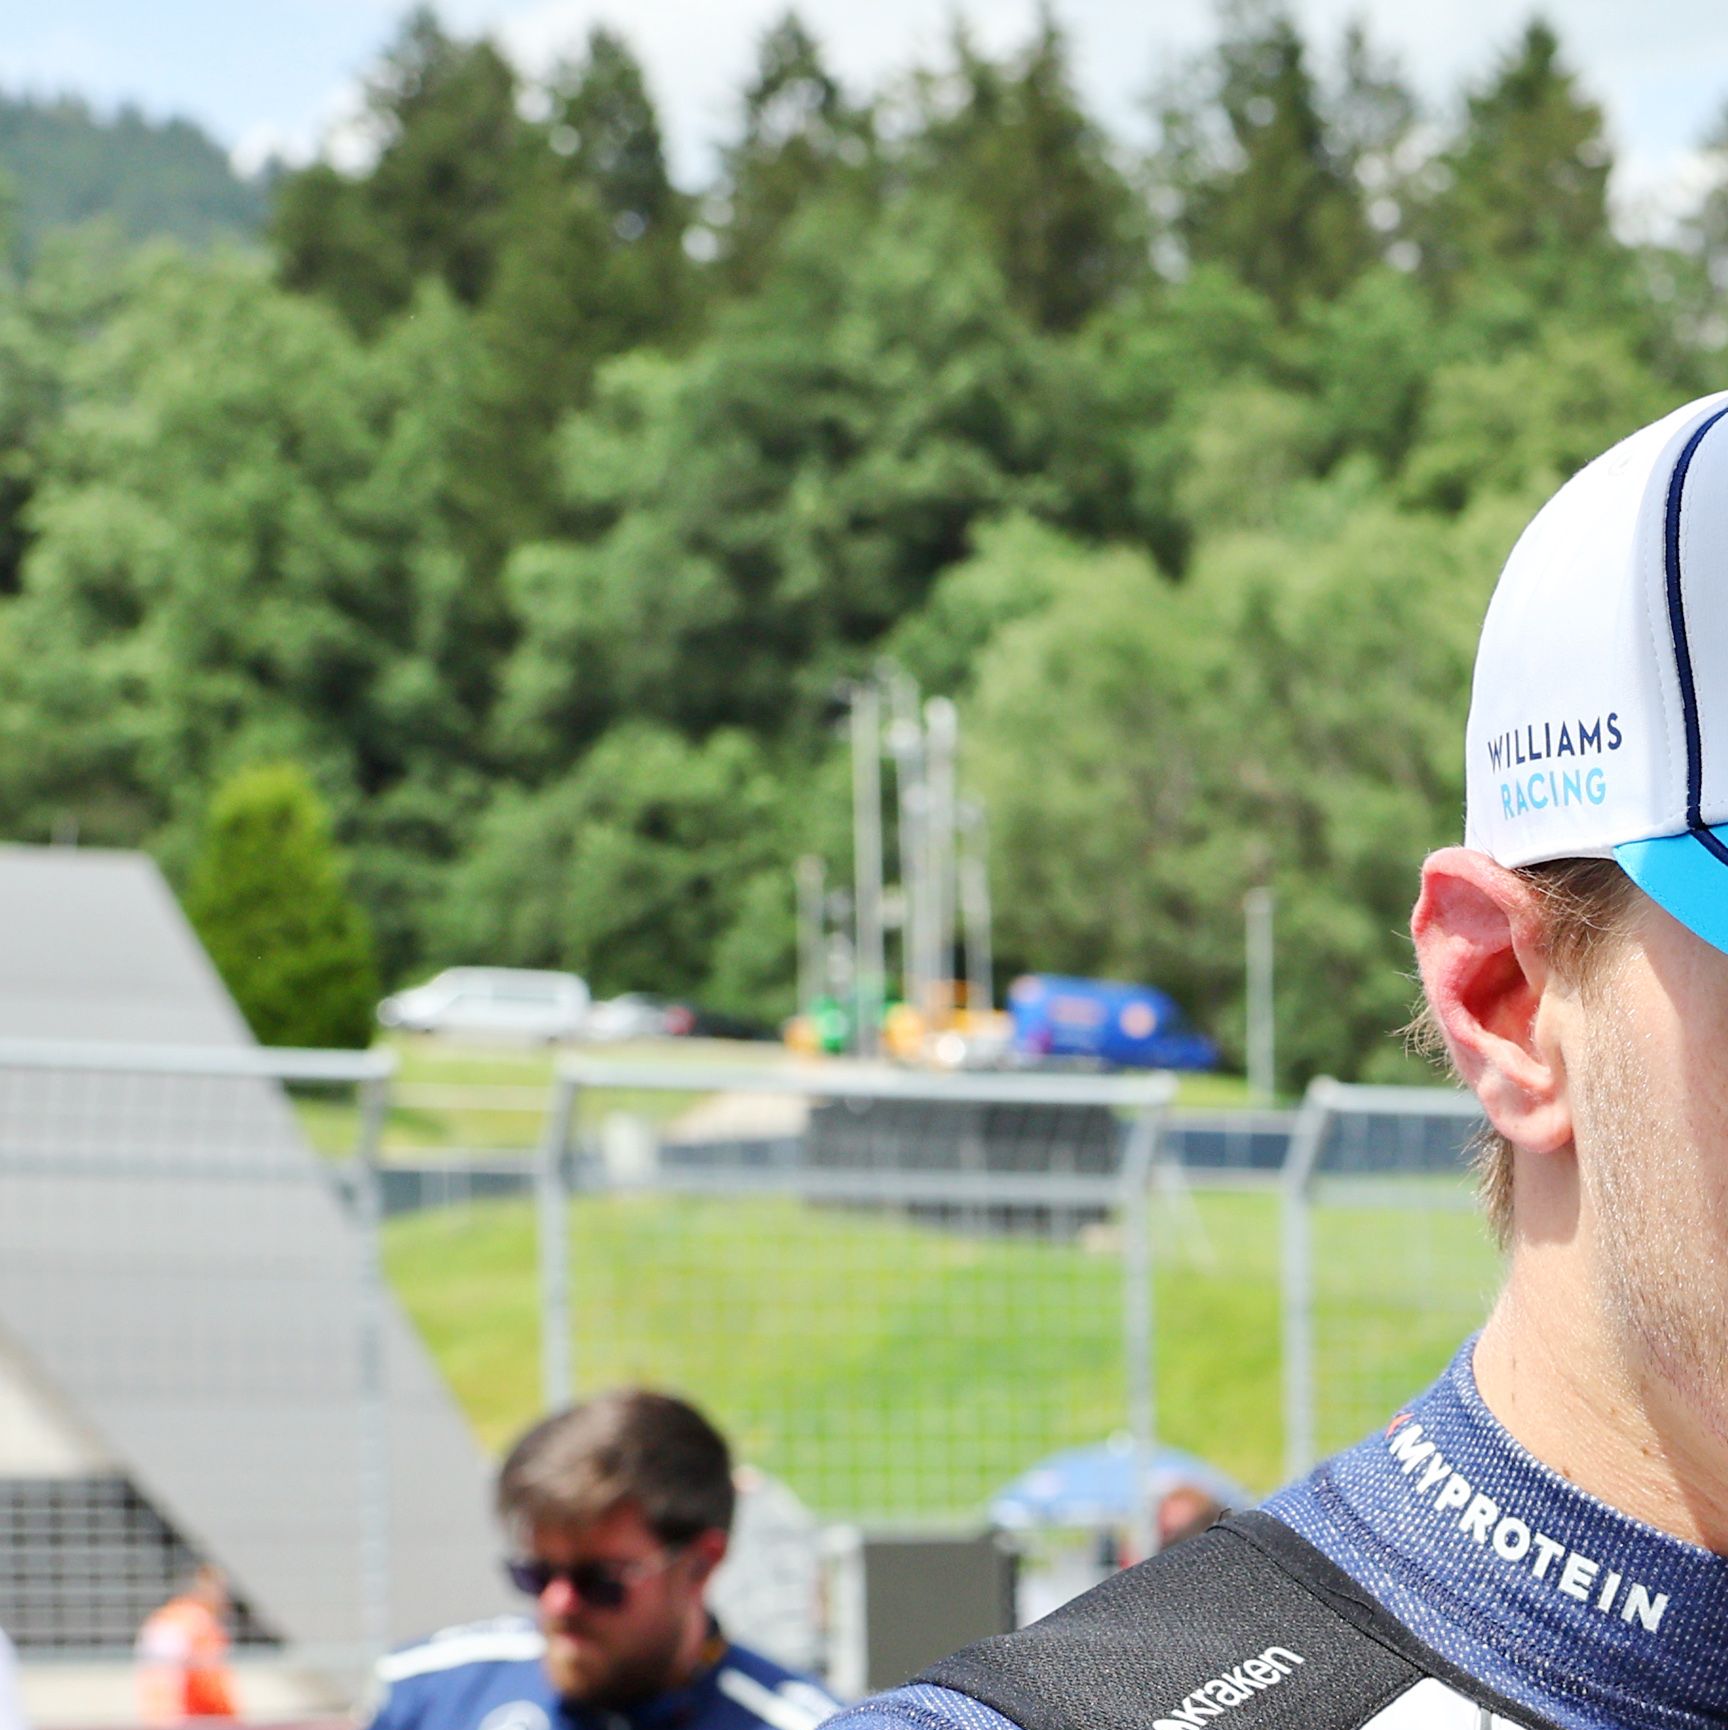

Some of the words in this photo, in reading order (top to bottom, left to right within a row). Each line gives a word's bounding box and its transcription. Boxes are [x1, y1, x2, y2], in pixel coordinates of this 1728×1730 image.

[1487, 712, 1623, 775] WILLIAMS
[1500, 767, 1607, 821] RACING
[1388, 1423, 1669, 1634] MYPROTEIN
